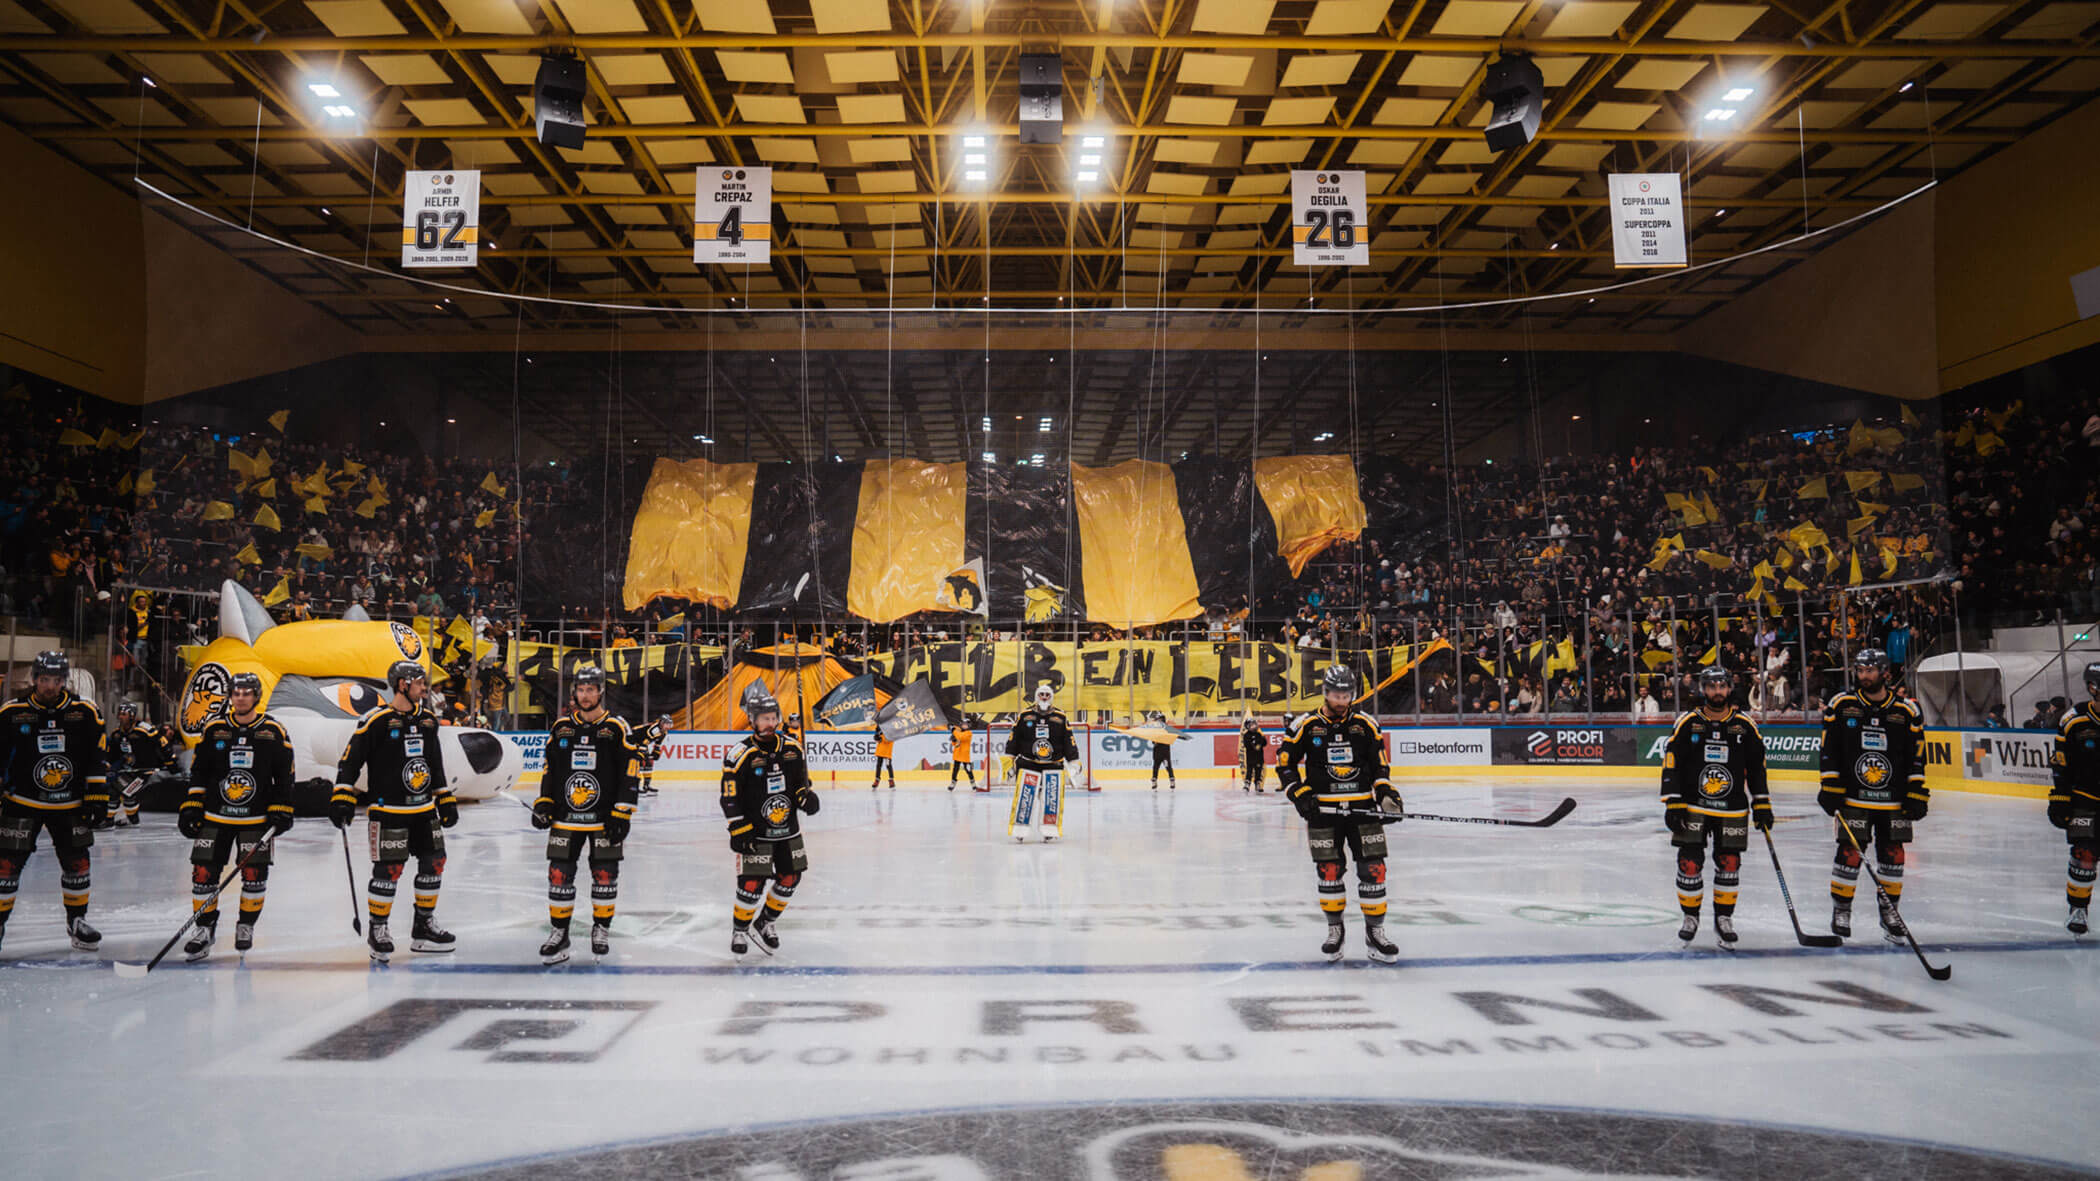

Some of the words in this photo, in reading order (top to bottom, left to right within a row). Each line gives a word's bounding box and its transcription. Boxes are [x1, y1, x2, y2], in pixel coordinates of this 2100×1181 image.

[424, 196, 460, 207] HELFER
[714, 192, 752, 202] CREPAZ
[1311, 196, 1348, 206] DEGILIA
[1622, 198, 1645, 206] COPPA
[1647, 197, 1670, 205] ITALIA
[416, 209, 467, 251] 62
[717, 205, 744, 247] 4
[1304, 208, 1355, 249] 26
[1624, 220, 1672, 229] SUPERCOPPA
[1081, 648, 1155, 686] EIN
[512, 735, 549, 747] BAUST
[1557, 730, 1604, 744] PROFI
[806, 741, 877, 755] RKASSE
[1418, 741, 1483, 754] betonform
[1762, 736, 1822, 751] RHOFER
[523, 748, 547, 759] MET
[1557, 745, 1605, 758] COLOR
[1764, 753, 1810, 762] MMOBILIARE
[723, 779, 737, 798] 13
[1722, 827, 1746, 837] FORS
[381, 839, 409, 850] FORST
[1361, 833, 1385, 845] FORS
[240, 842, 270, 852] FOST
[744, 854, 772, 865] FORST
[715, 979, 1937, 1037] PRENN
[701, 1042, 1239, 1065] WOHNBAU
[1355, 1022, 2014, 1060] IMMOBILIEN
